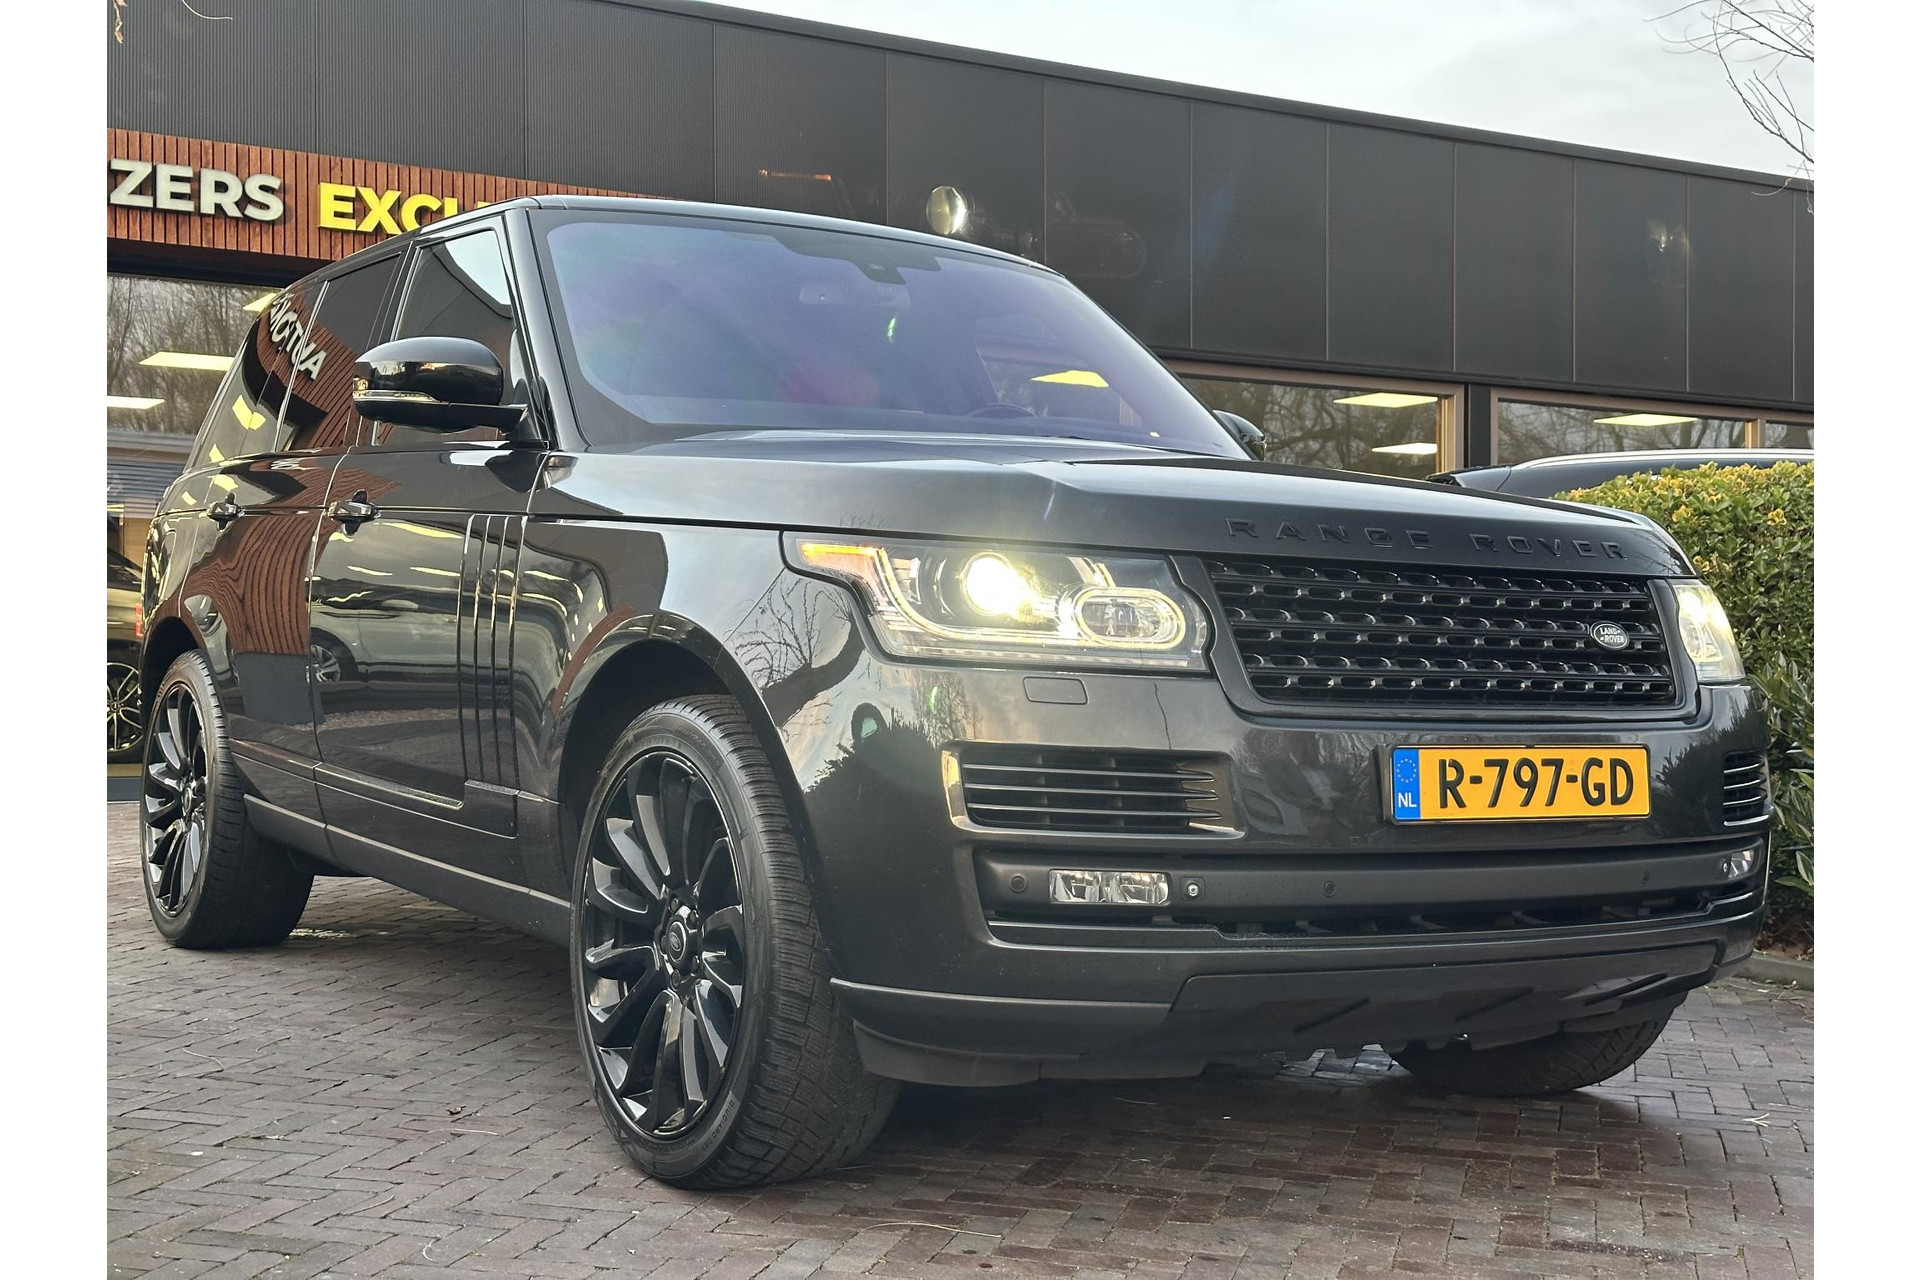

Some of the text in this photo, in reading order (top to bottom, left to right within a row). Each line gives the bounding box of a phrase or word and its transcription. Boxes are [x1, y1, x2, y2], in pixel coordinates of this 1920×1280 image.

[109, 158, 491, 236] ZERS EXC
[1224, 518, 1628, 561] RANGE ROVER
[1398, 792, 1417, 808] NL
[1438, 757, 1635, 809] R-797-GD
